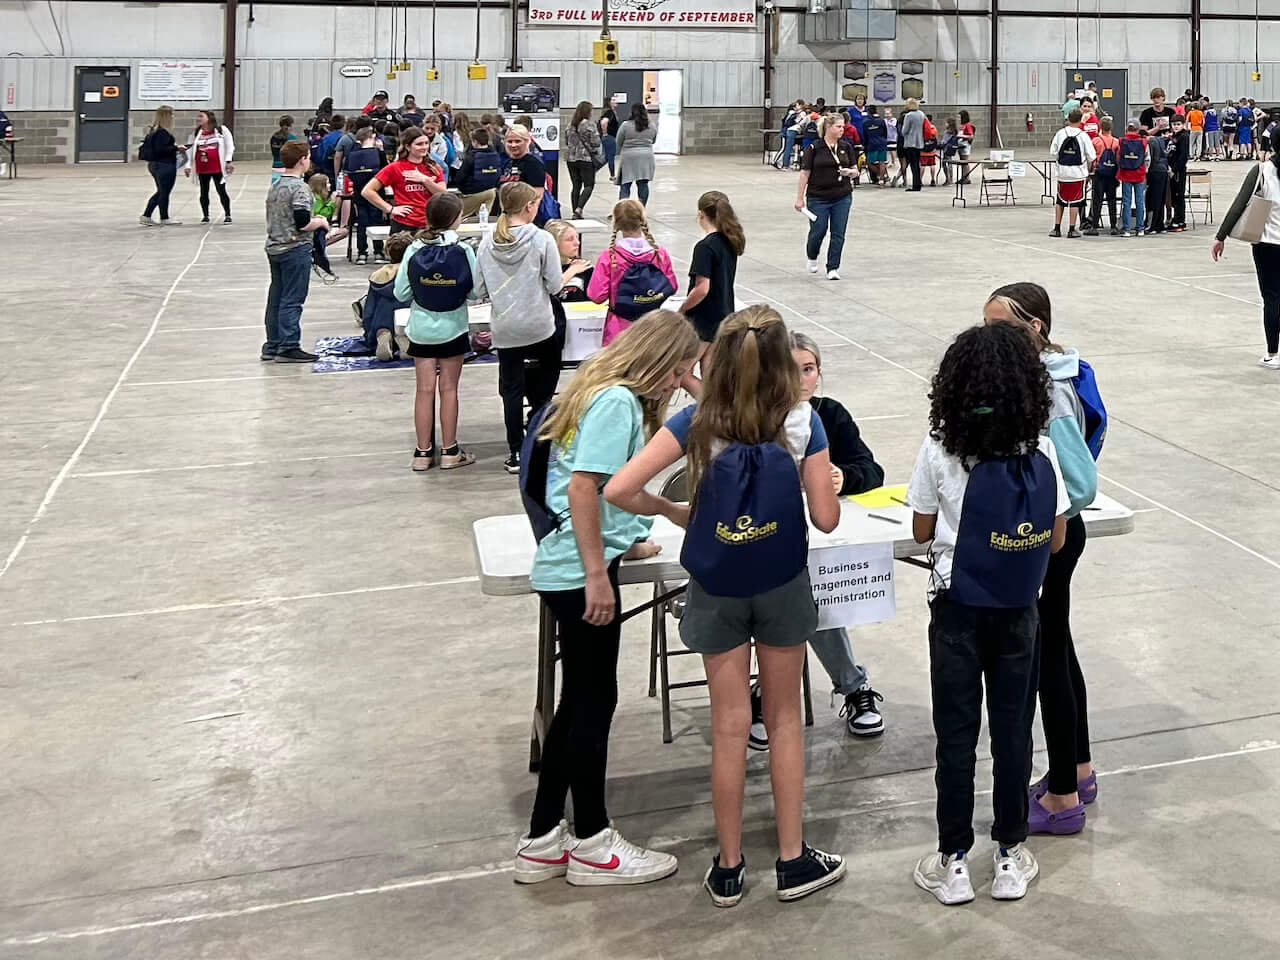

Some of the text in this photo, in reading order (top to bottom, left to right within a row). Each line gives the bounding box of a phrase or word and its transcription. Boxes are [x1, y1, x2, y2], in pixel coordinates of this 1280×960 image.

[530, 9, 755, 24] 3RD FULL WEEKEND OF SEPTEMBER
[715, 521, 778, 542] EdisonState
[990, 529, 1052, 548] EdisonState
[818, 561, 870, 575] Business
[811, 571, 891, 592] nagement and
[815, 589, 886, 606] dministration
